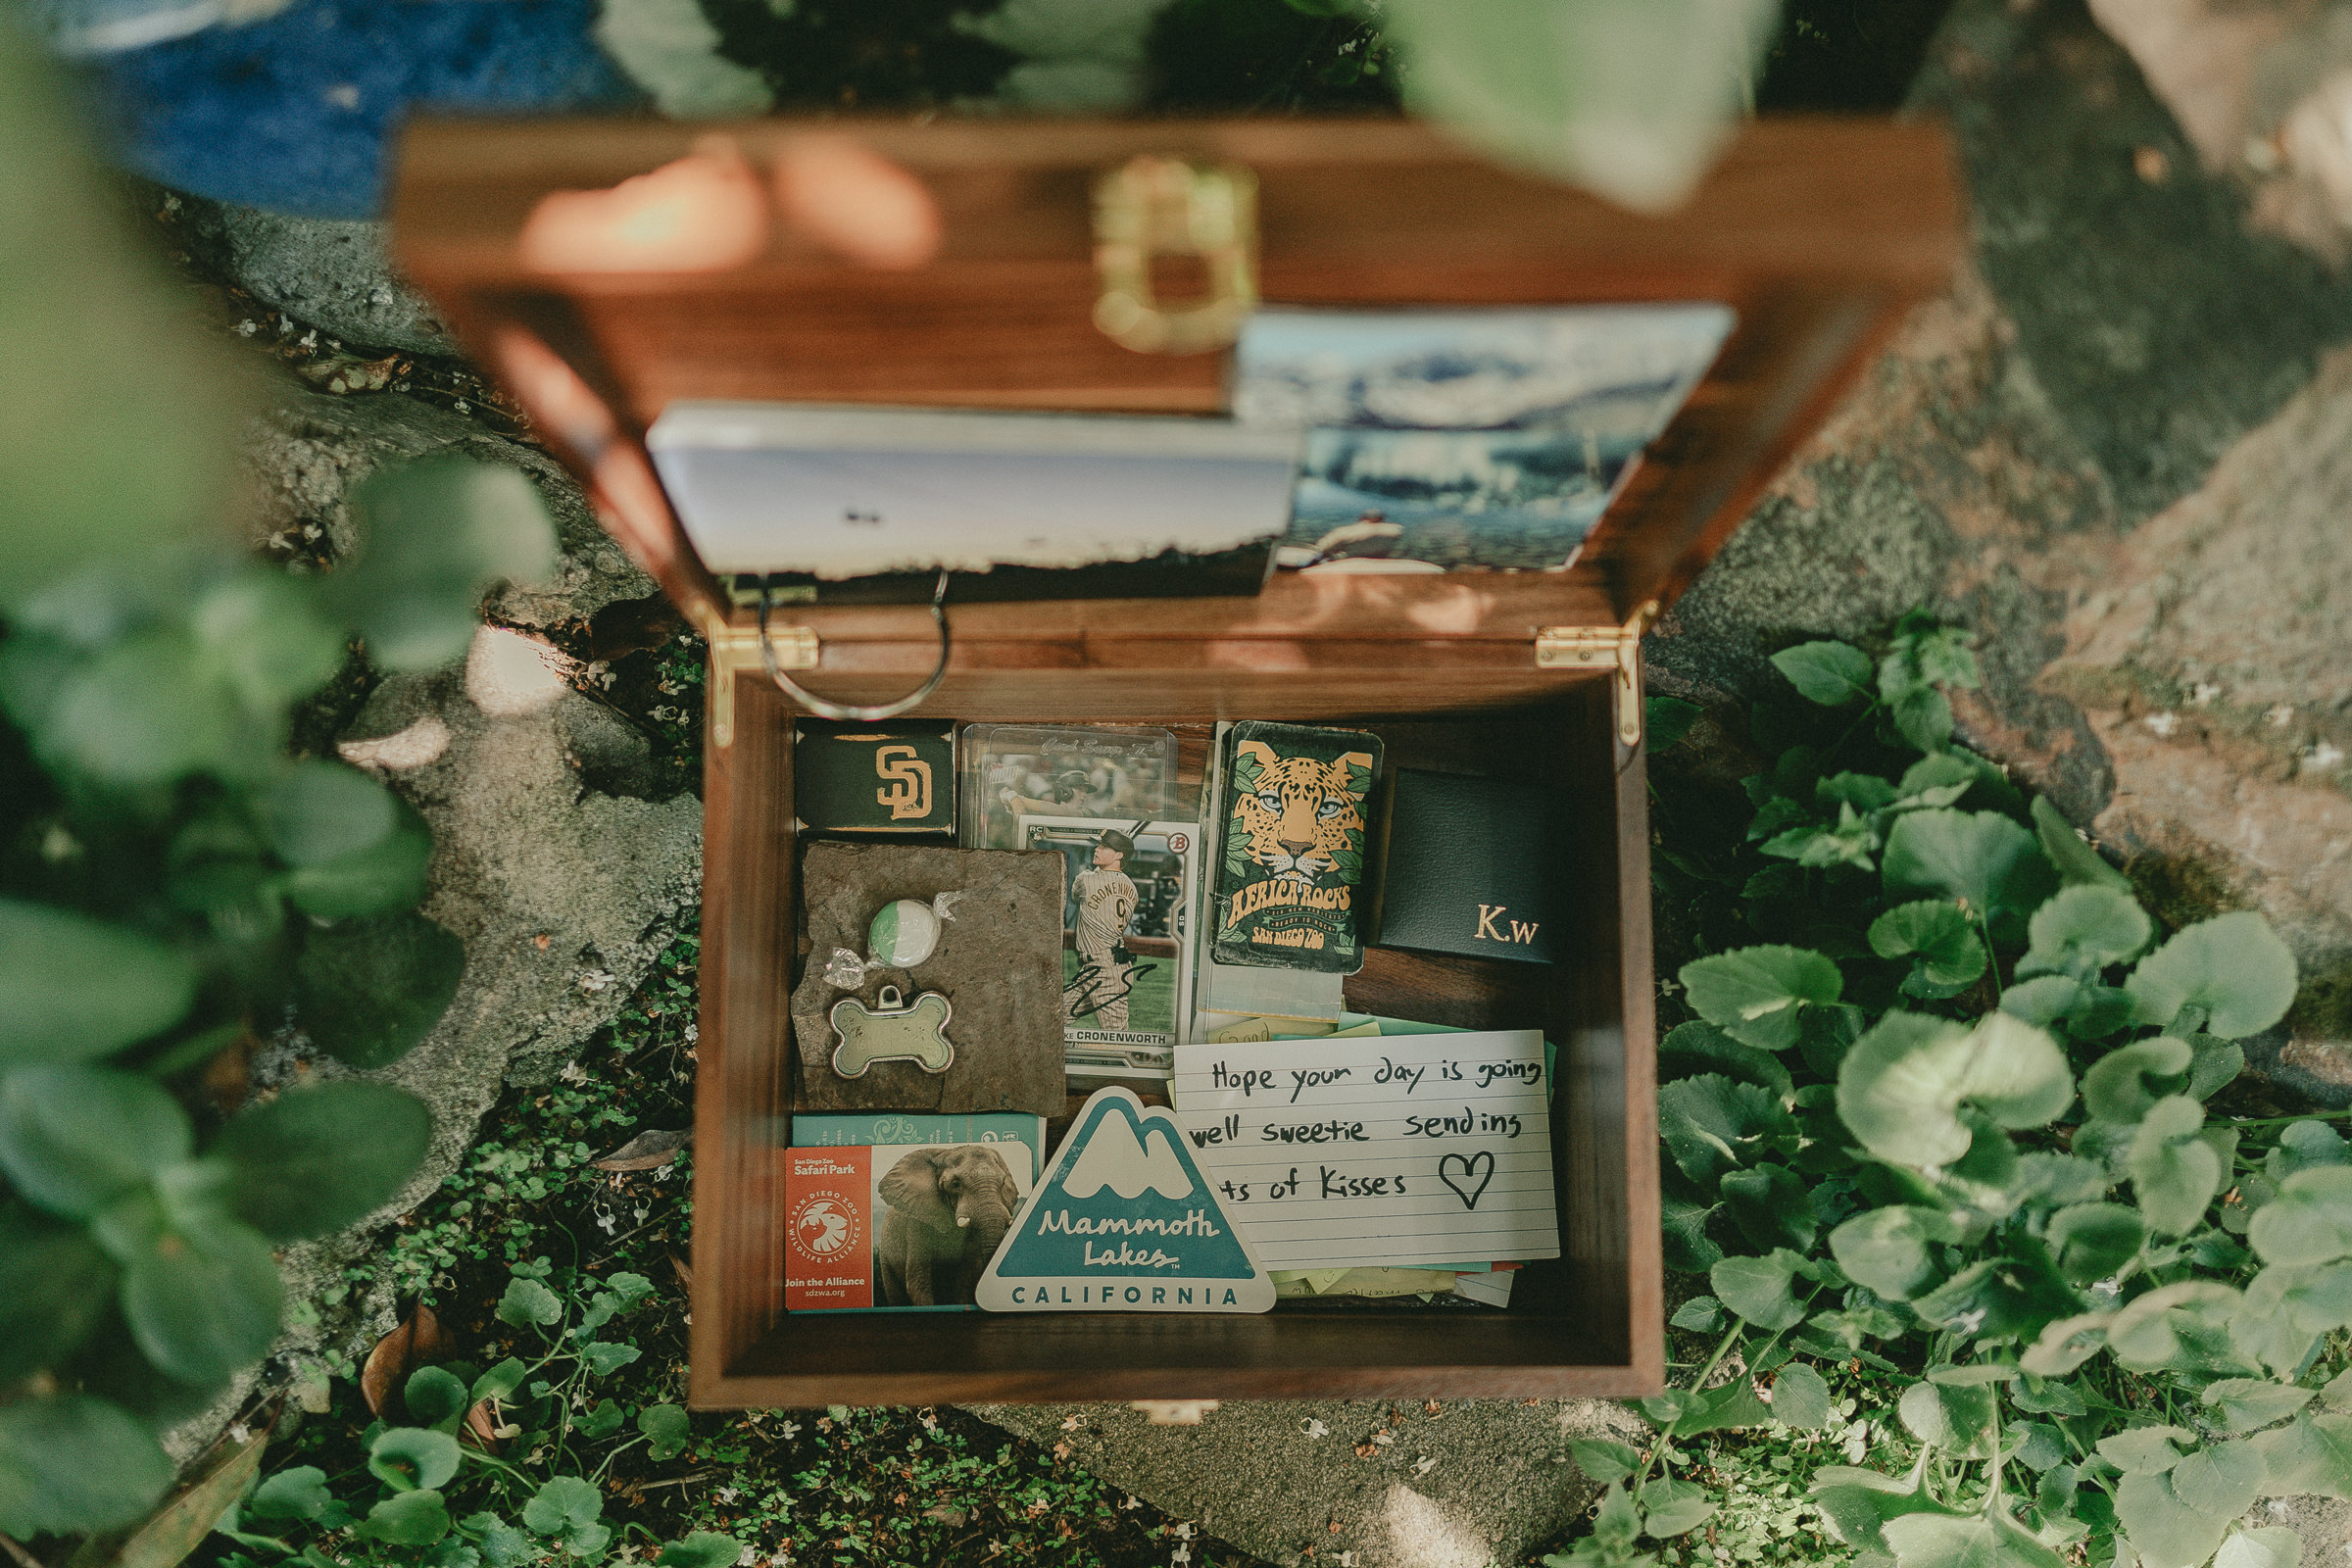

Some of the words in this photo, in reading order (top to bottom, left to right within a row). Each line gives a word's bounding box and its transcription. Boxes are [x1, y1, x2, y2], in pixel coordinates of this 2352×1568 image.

[876, 745, 932, 820] SD
[1227, 879, 1298, 929] AFRICA
[1300, 883, 1351, 911] ROCKS
[1275, 916, 1298, 927] READY
[1314, 919, 1333, 931] ROCK
[1251, 926, 1273, 945] SAN
[1273, 927, 1304, 948] DIEGO
[1303, 927, 1325, 950] ZOO
[1076, 1031, 1166, 1044] CRONENWORTH
[1212, 1060, 1276, 1097] Hope
[1291, 1067, 1351, 1103] your
[1374, 1056, 1425, 1095] day
[1442, 1059, 1463, 1080] is
[1475, 1059, 1543, 1089] going
[1189, 1114, 1240, 1149] well
[1260, 1119, 1371, 1145] sweetie
[1402, 1106, 1523, 1139] sending
[794, 1165, 828, 1176] Safari
[829, 1164, 856, 1175] Park
[1219, 1180, 1251, 1202] ts
[1270, 1167, 1299, 1200] of
[792, 1199, 807, 1216] SAN
[809, 1190, 840, 1200] DIEGO
[843, 1197, 858, 1215] ZOO
[1037, 1208, 1220, 1237] Mammoth
[789, 1228, 822, 1263] WILDLIFE
[827, 1226, 860, 1263] ALLIANCE
[1084, 1240, 1180, 1268] Lakes
[805, 1289, 846, 1298] sdzwa.org
[807, 1278, 823, 1287] the
[825, 1276, 865, 1287] Alliance
[1010, 1286, 1238, 1305] CALIFORNIA
